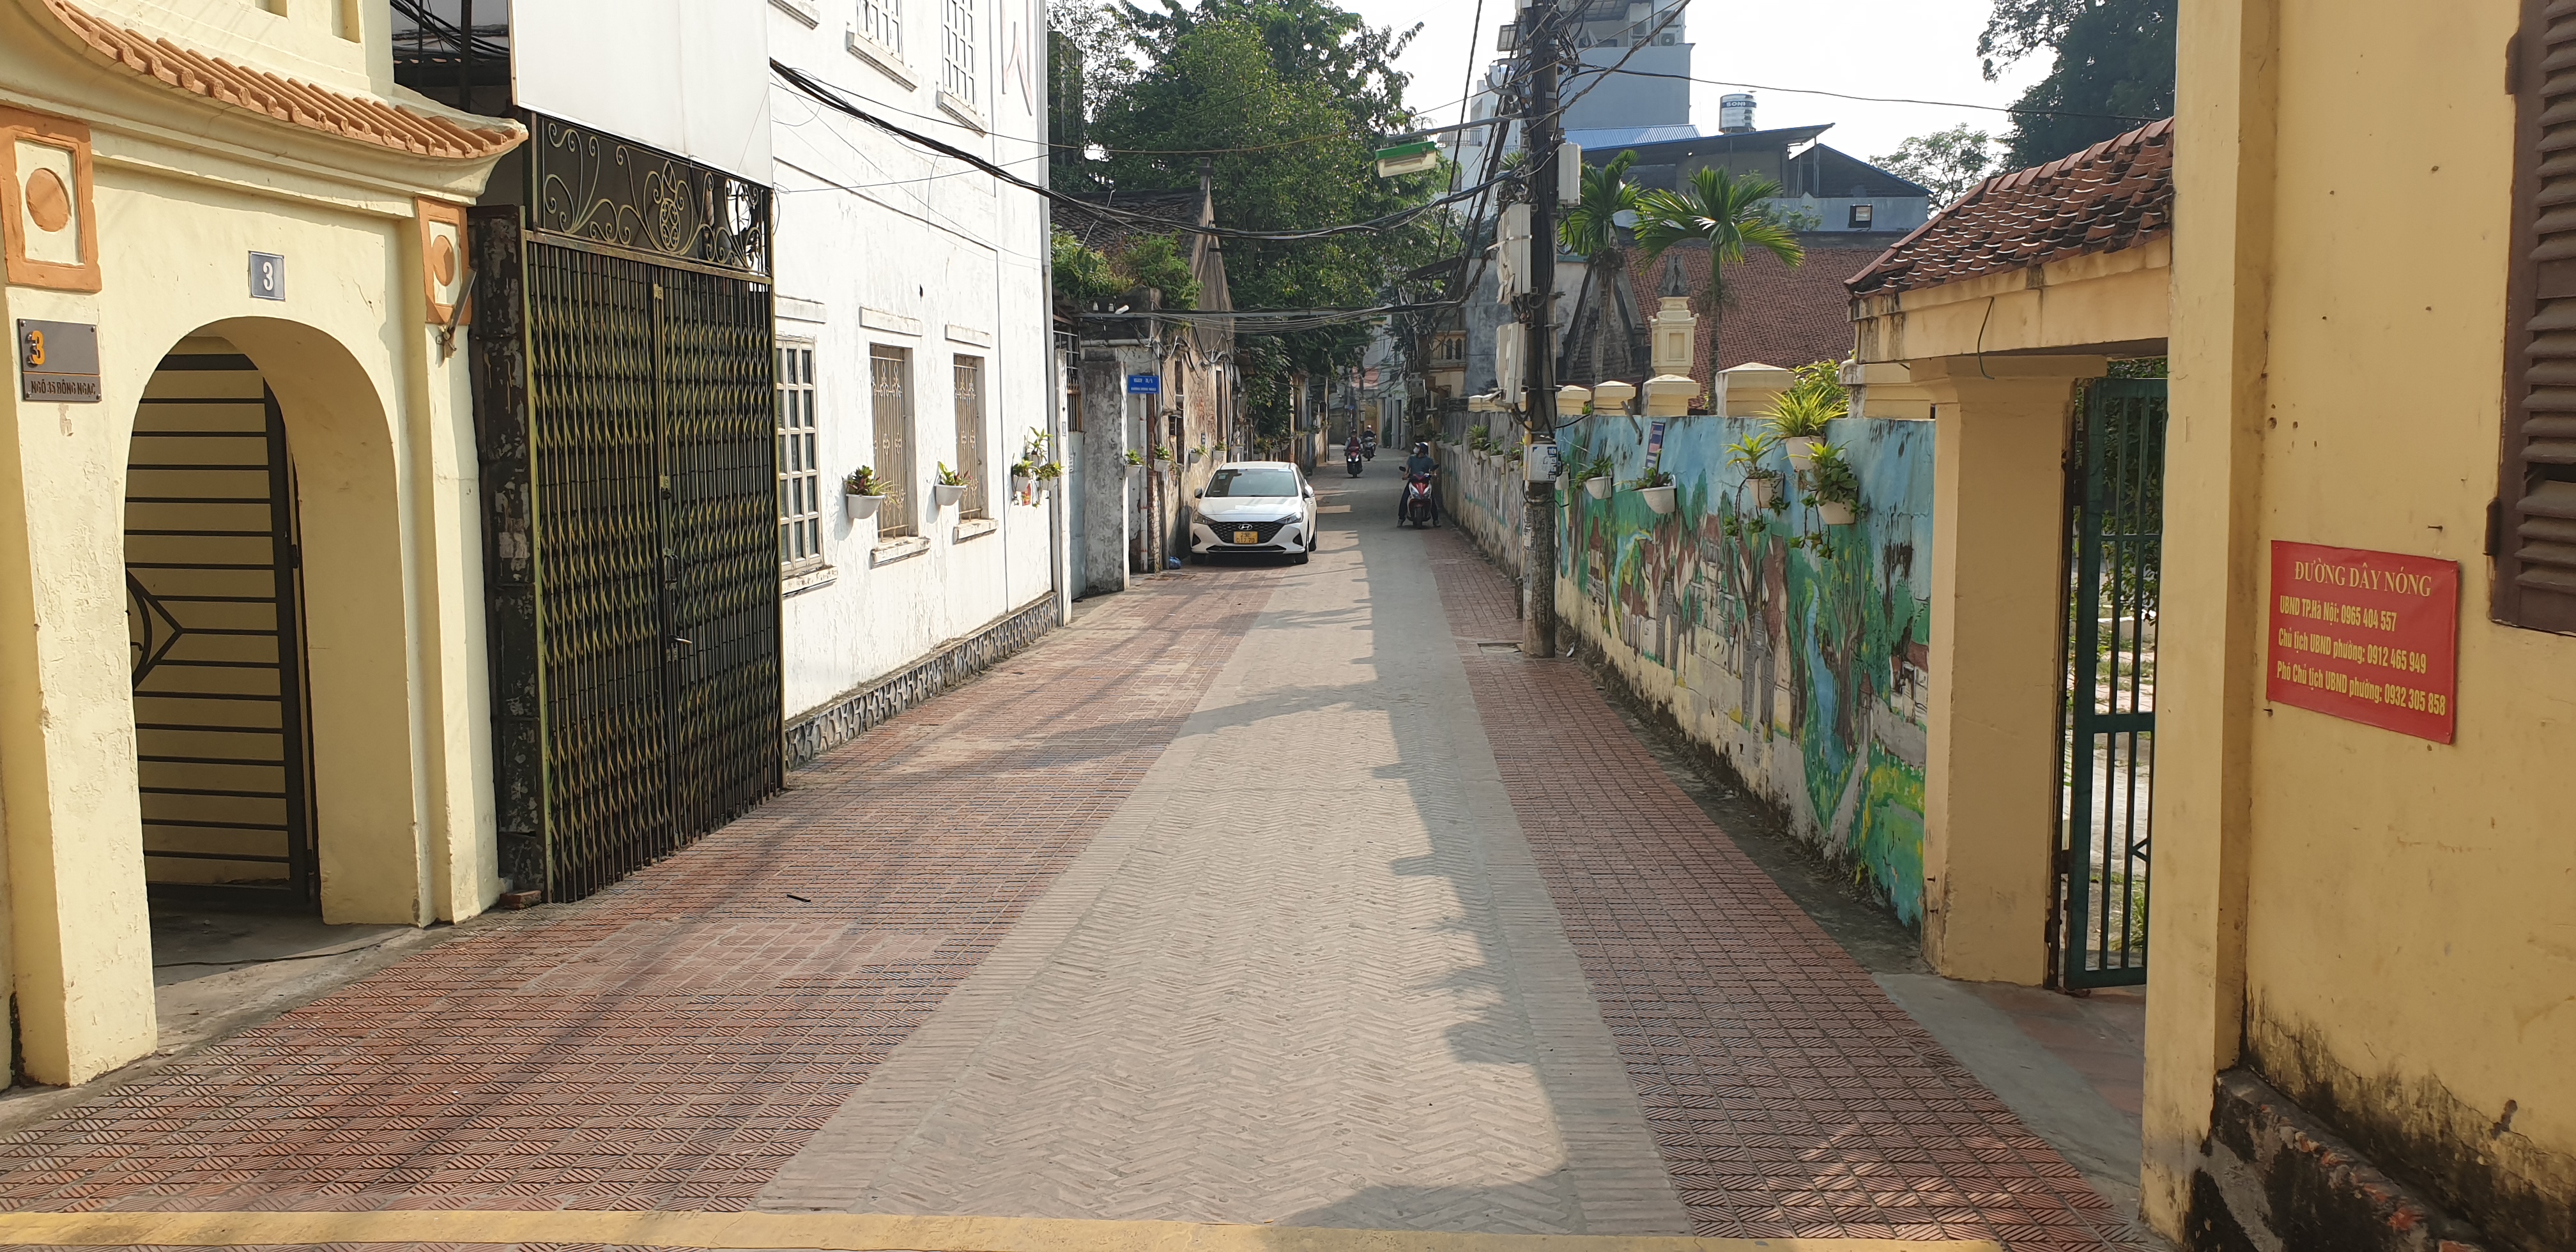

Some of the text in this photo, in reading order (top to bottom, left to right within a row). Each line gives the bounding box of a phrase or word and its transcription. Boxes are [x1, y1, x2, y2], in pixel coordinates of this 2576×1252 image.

[263, 261, 273, 291] 3
[32, 330, 45, 365] 3
[47, 381, 56, 393] 35
[2295, 558, 2432, 597] ĐƯỜNG DÂY NÓNG
[2280, 595, 2397, 632] UBND TP.Hà Nội: 0965 404 557
[2278, 627, 2426, 674] Chủ tịch UBND phường: 0912 465 949
[2277, 660, 2446, 716] Phó Chủ tịch UBND phường: 0932 305 858
